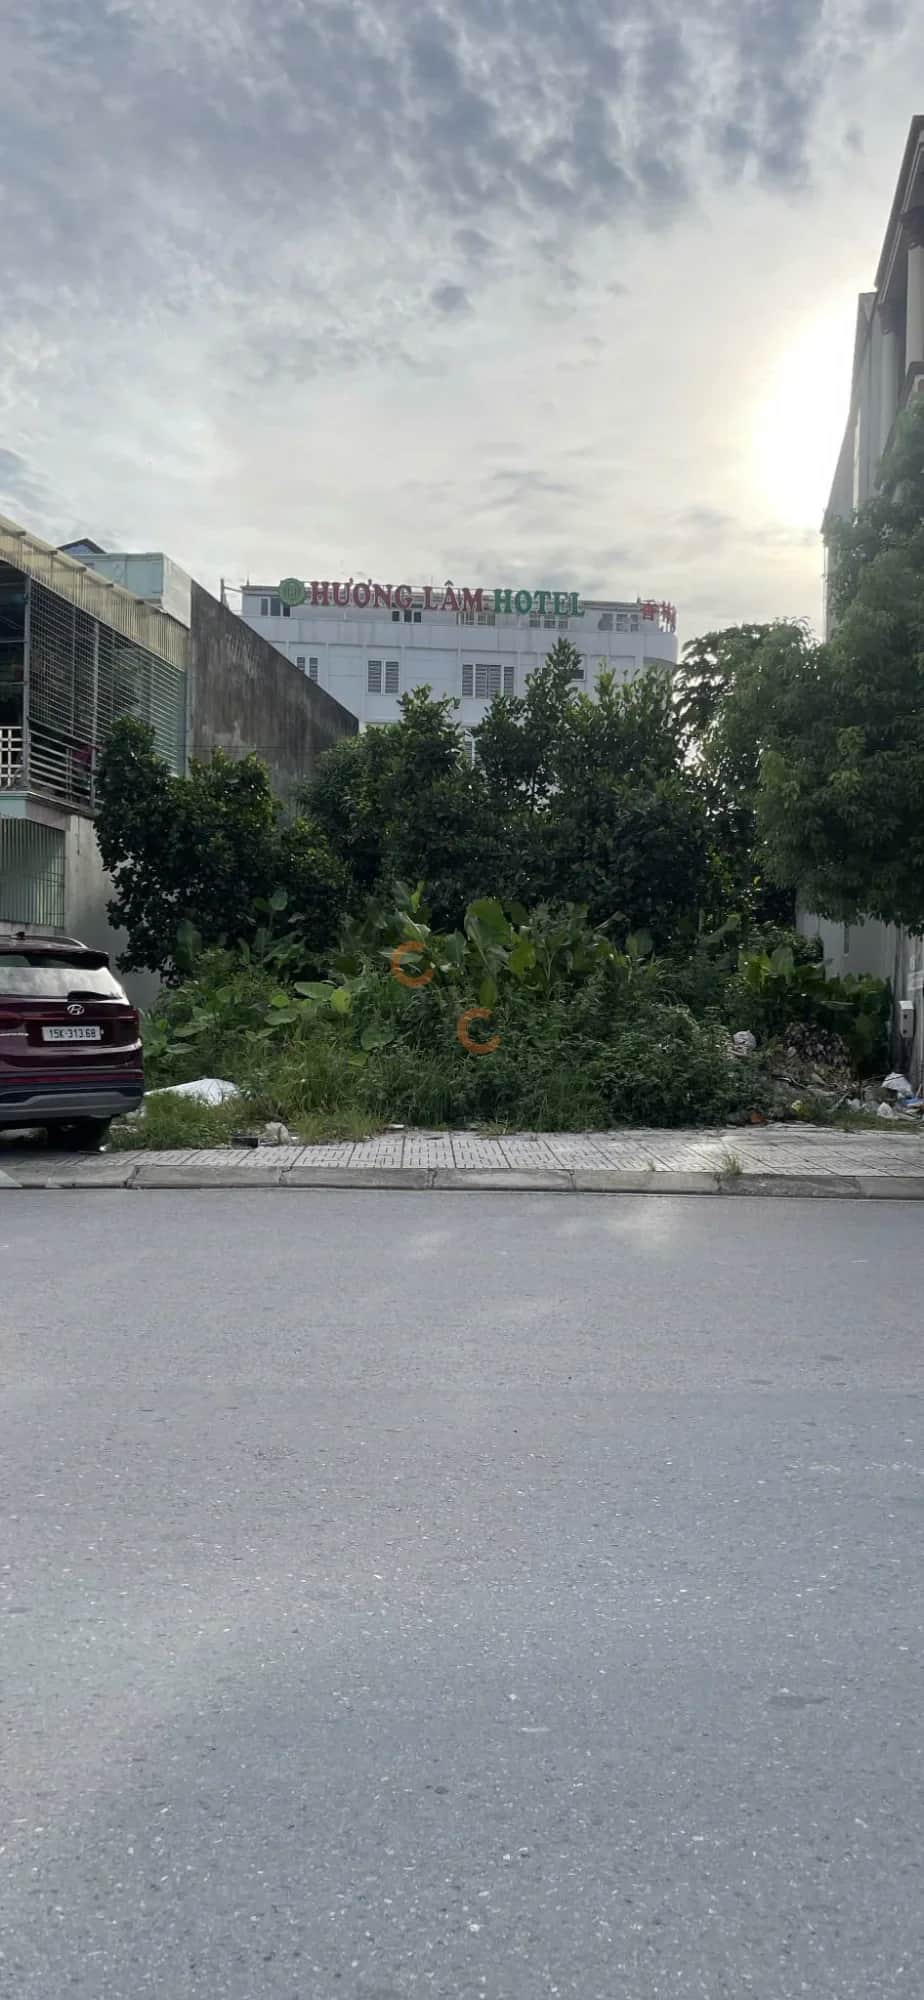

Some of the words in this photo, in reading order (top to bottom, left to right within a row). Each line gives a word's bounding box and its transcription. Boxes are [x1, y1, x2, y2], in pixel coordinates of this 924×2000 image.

[311, 578, 413, 608] HƯƠNG
[423, 580, 483, 612] LÂM
[494, 589, 585, 616] HOTEL
